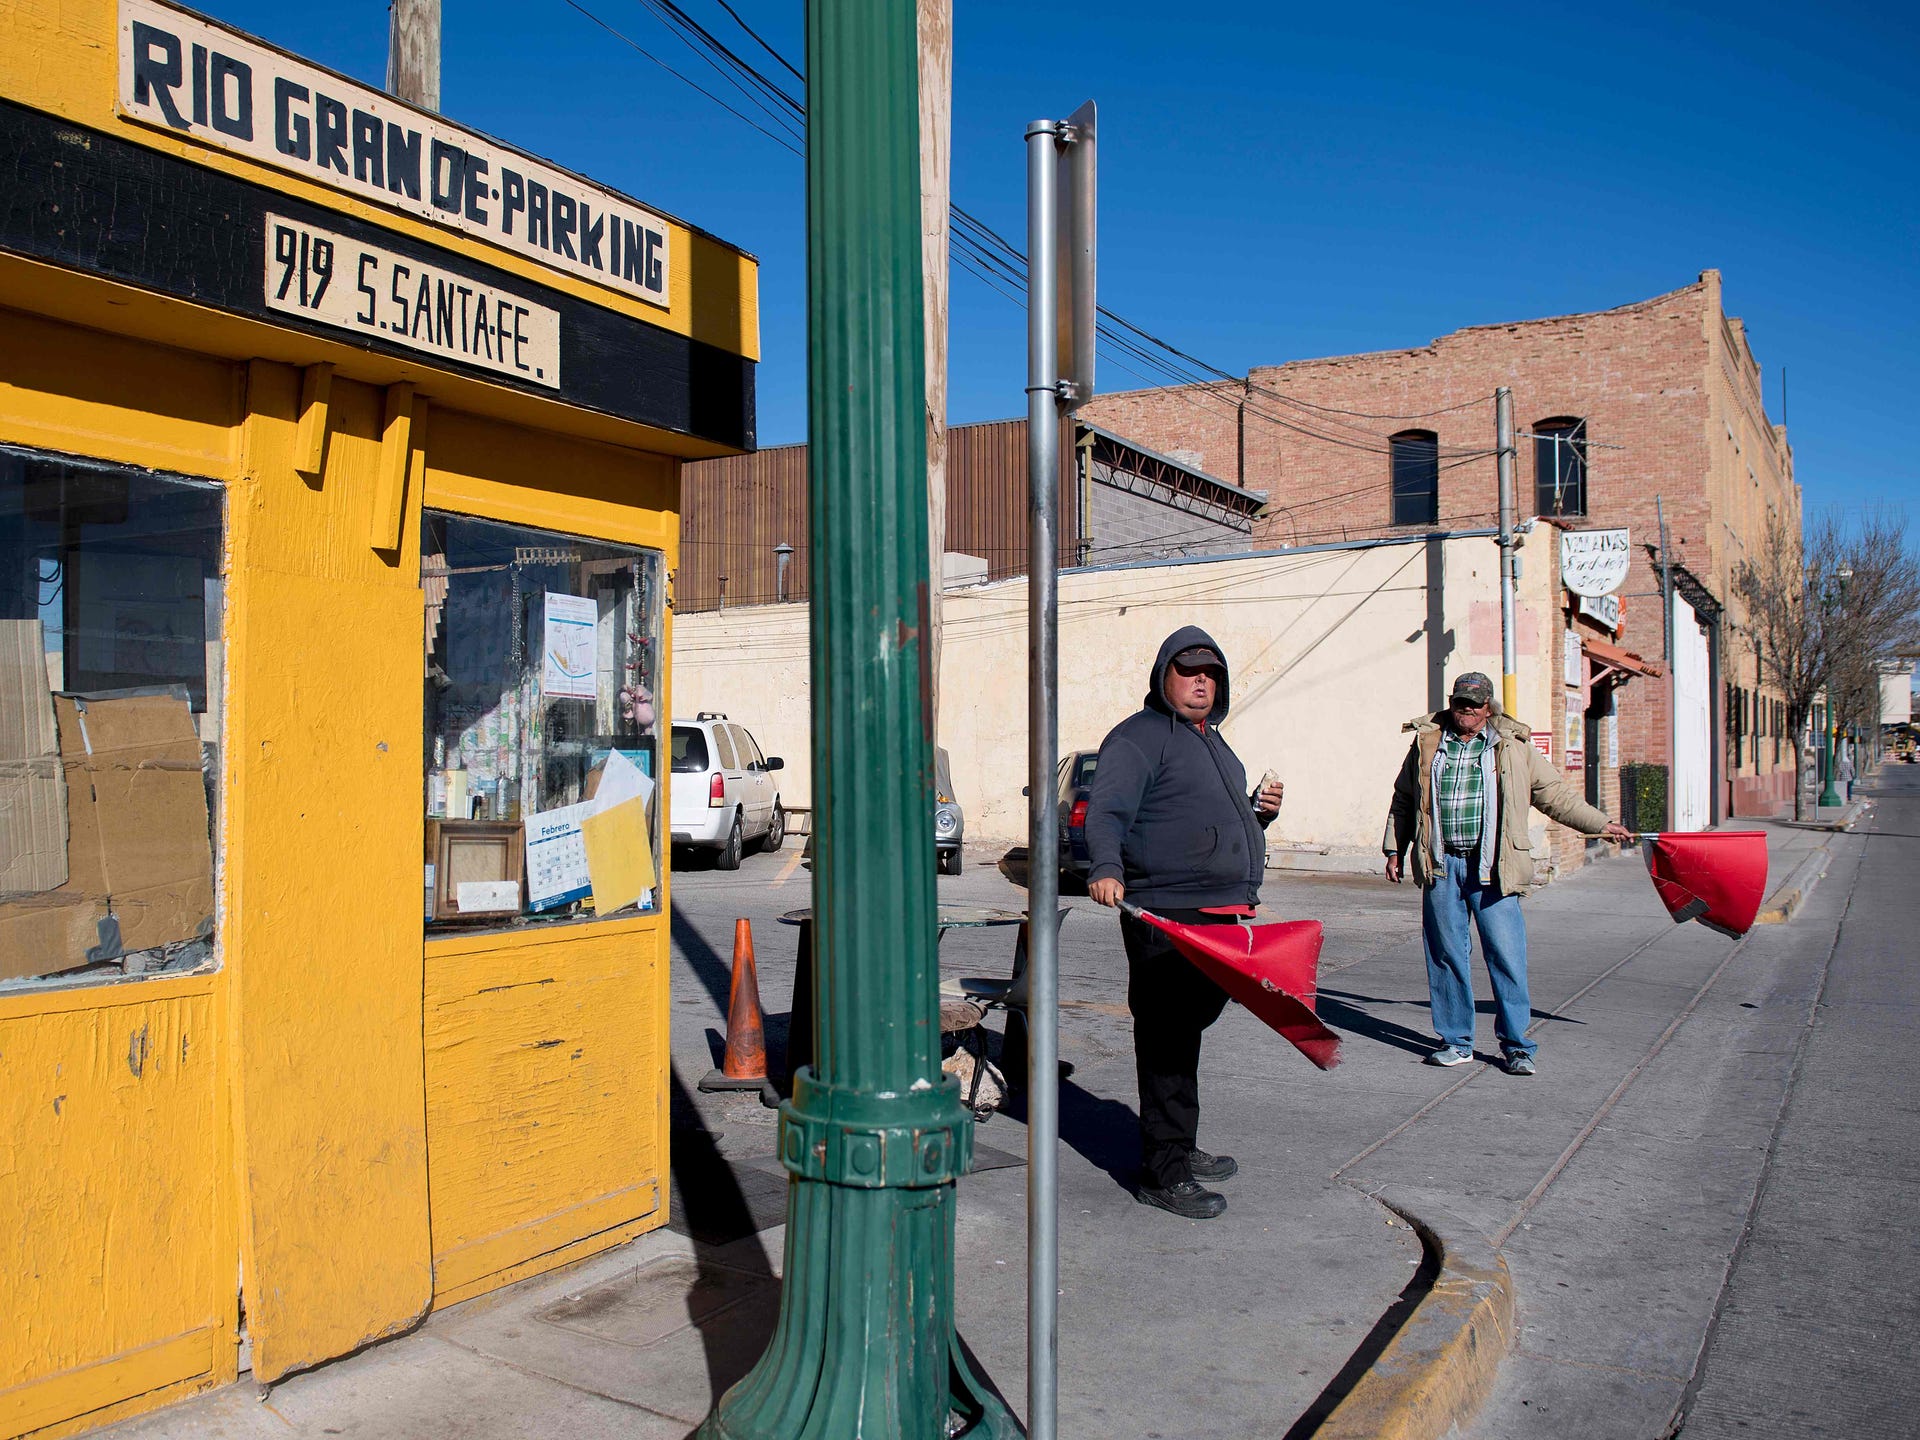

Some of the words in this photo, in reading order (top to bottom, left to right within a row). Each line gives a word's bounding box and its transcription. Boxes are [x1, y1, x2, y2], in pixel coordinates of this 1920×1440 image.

[133, 20, 253, 142] RIO
[275, 224, 334, 309] 919
[541, 823, 570, 836] Febrero
